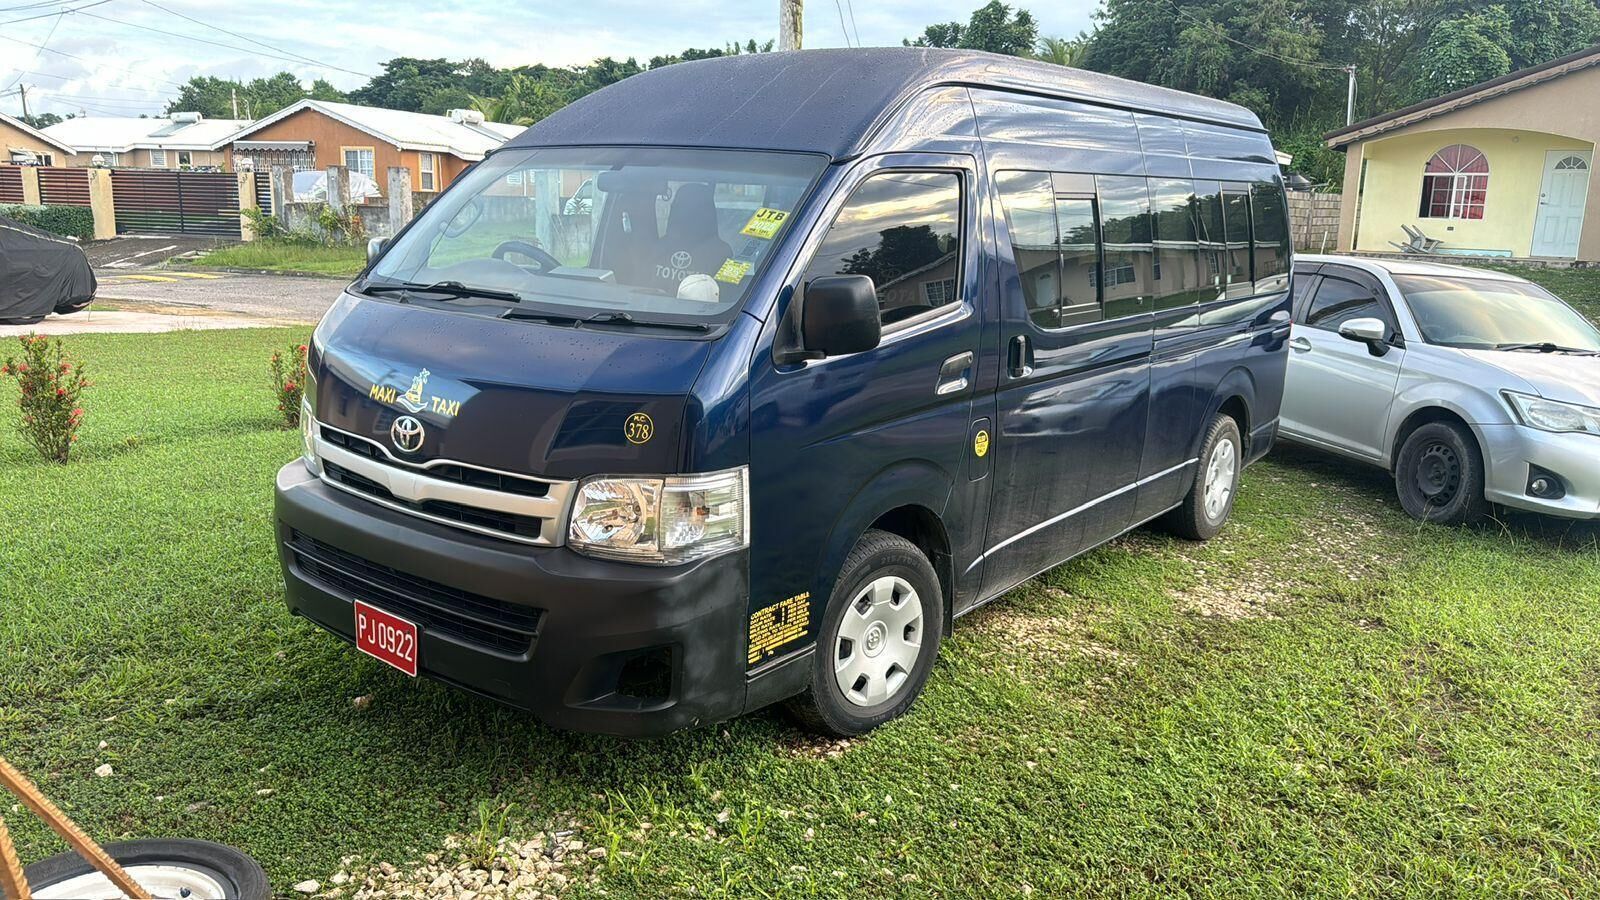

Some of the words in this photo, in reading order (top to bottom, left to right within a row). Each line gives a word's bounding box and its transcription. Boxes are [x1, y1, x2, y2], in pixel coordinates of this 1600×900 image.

[756, 209, 785, 220] JTB
[656, 265, 702, 281] TOYO
[369, 384, 396, 404] MAXI
[431, 396, 460, 416] TAXI
[628, 422, 649, 439] 378
[751, 603, 779, 619] CONTRACT
[780, 598, 794, 608] FARE
[795, 591, 810, 601] TABLE
[358, 613, 413, 662] PJ0922
